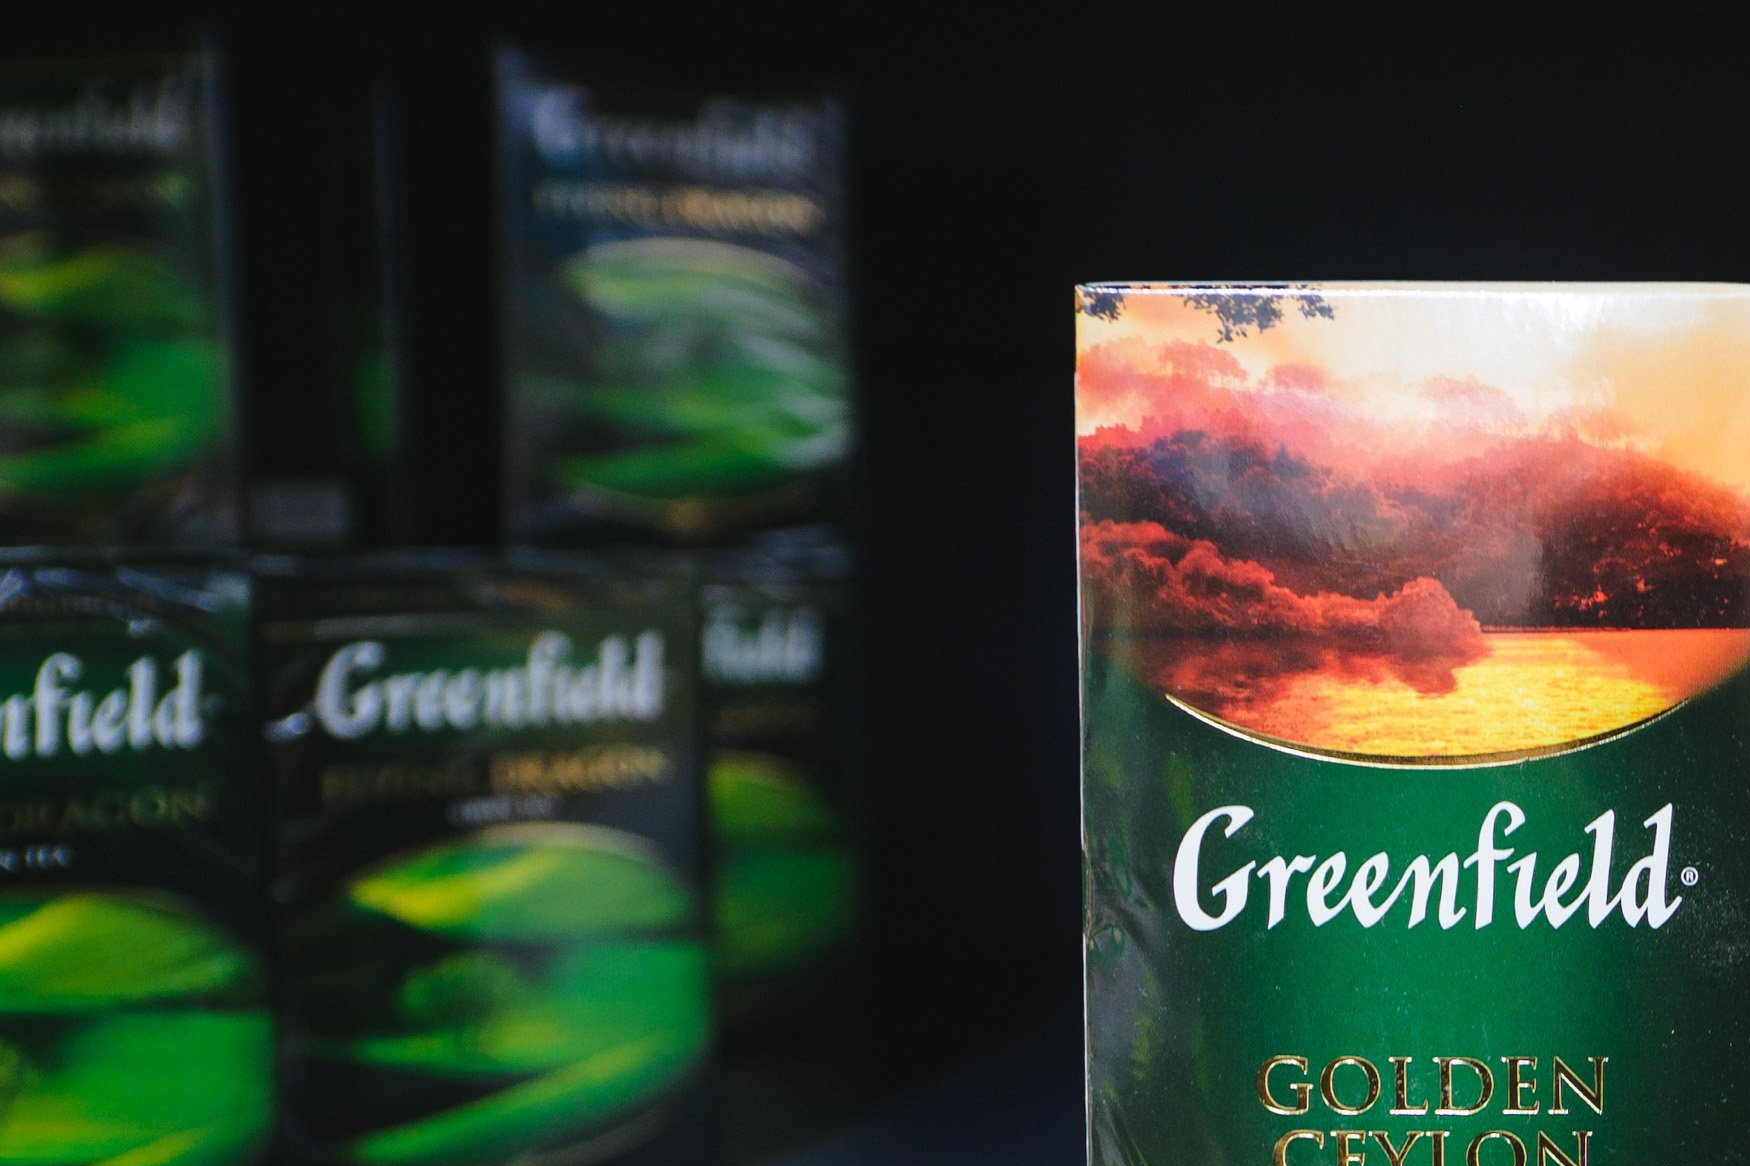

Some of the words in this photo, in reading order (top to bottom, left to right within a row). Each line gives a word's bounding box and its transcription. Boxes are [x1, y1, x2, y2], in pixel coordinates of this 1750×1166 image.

[314, 631, 666, 740] Greenfield
[1172, 800, 1683, 931] Greenfield
[1256, 1054, 1609, 1116] GOLDEN
